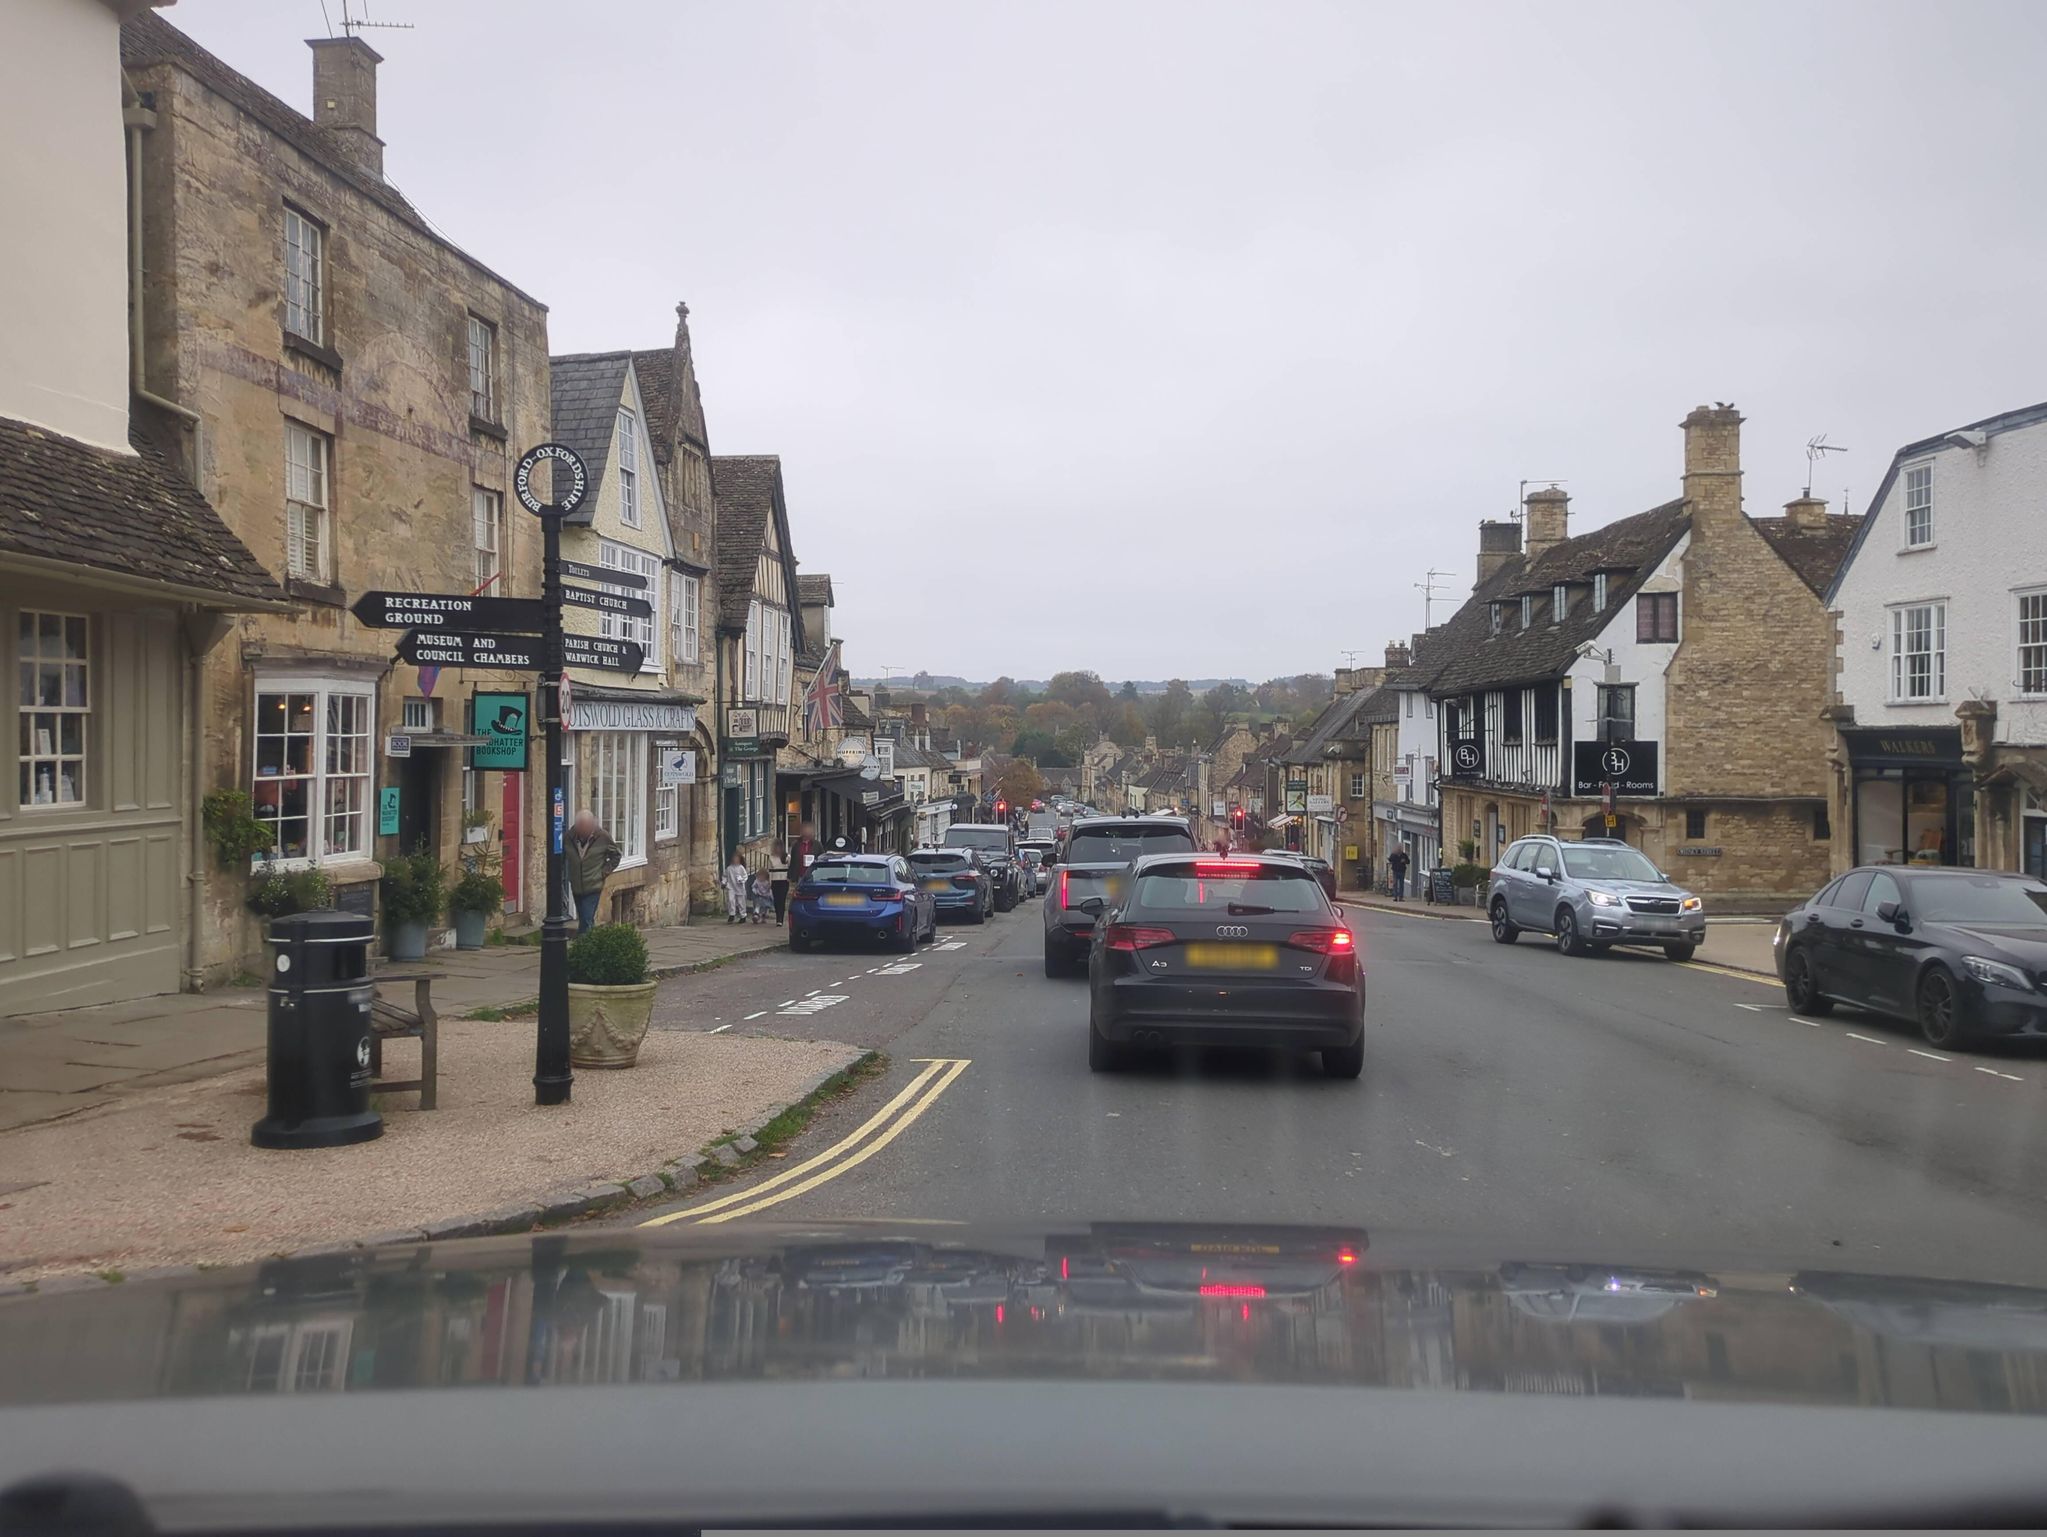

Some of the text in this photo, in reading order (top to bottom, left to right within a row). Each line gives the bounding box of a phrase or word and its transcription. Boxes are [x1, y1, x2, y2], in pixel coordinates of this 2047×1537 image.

[385, 597, 473, 611] RECREATION
[565, 589, 627, 610] BAPTIST CHURCH
[385, 613, 444, 625] GROUND
[416, 634, 496, 649] MUSEUM AND
[565, 638, 589, 650] PARISH
[593, 642, 619, 653] CHURCH
[416, 650, 530, 665] COUNCIL CHAMBERS
[565, 652, 620, 667] WARWICK HALL
[569, 703, 695, 729] OTSWOLD GLASS & CRAFTS
[476, 746, 517, 756] BOOKSHOP
[1880, 740, 1936, 754] WALKERS
[1578, 781, 1592, 789] Bar
[1626, 780, 1654, 789] Rooms
[1152, 960, 1168, 968] A3
